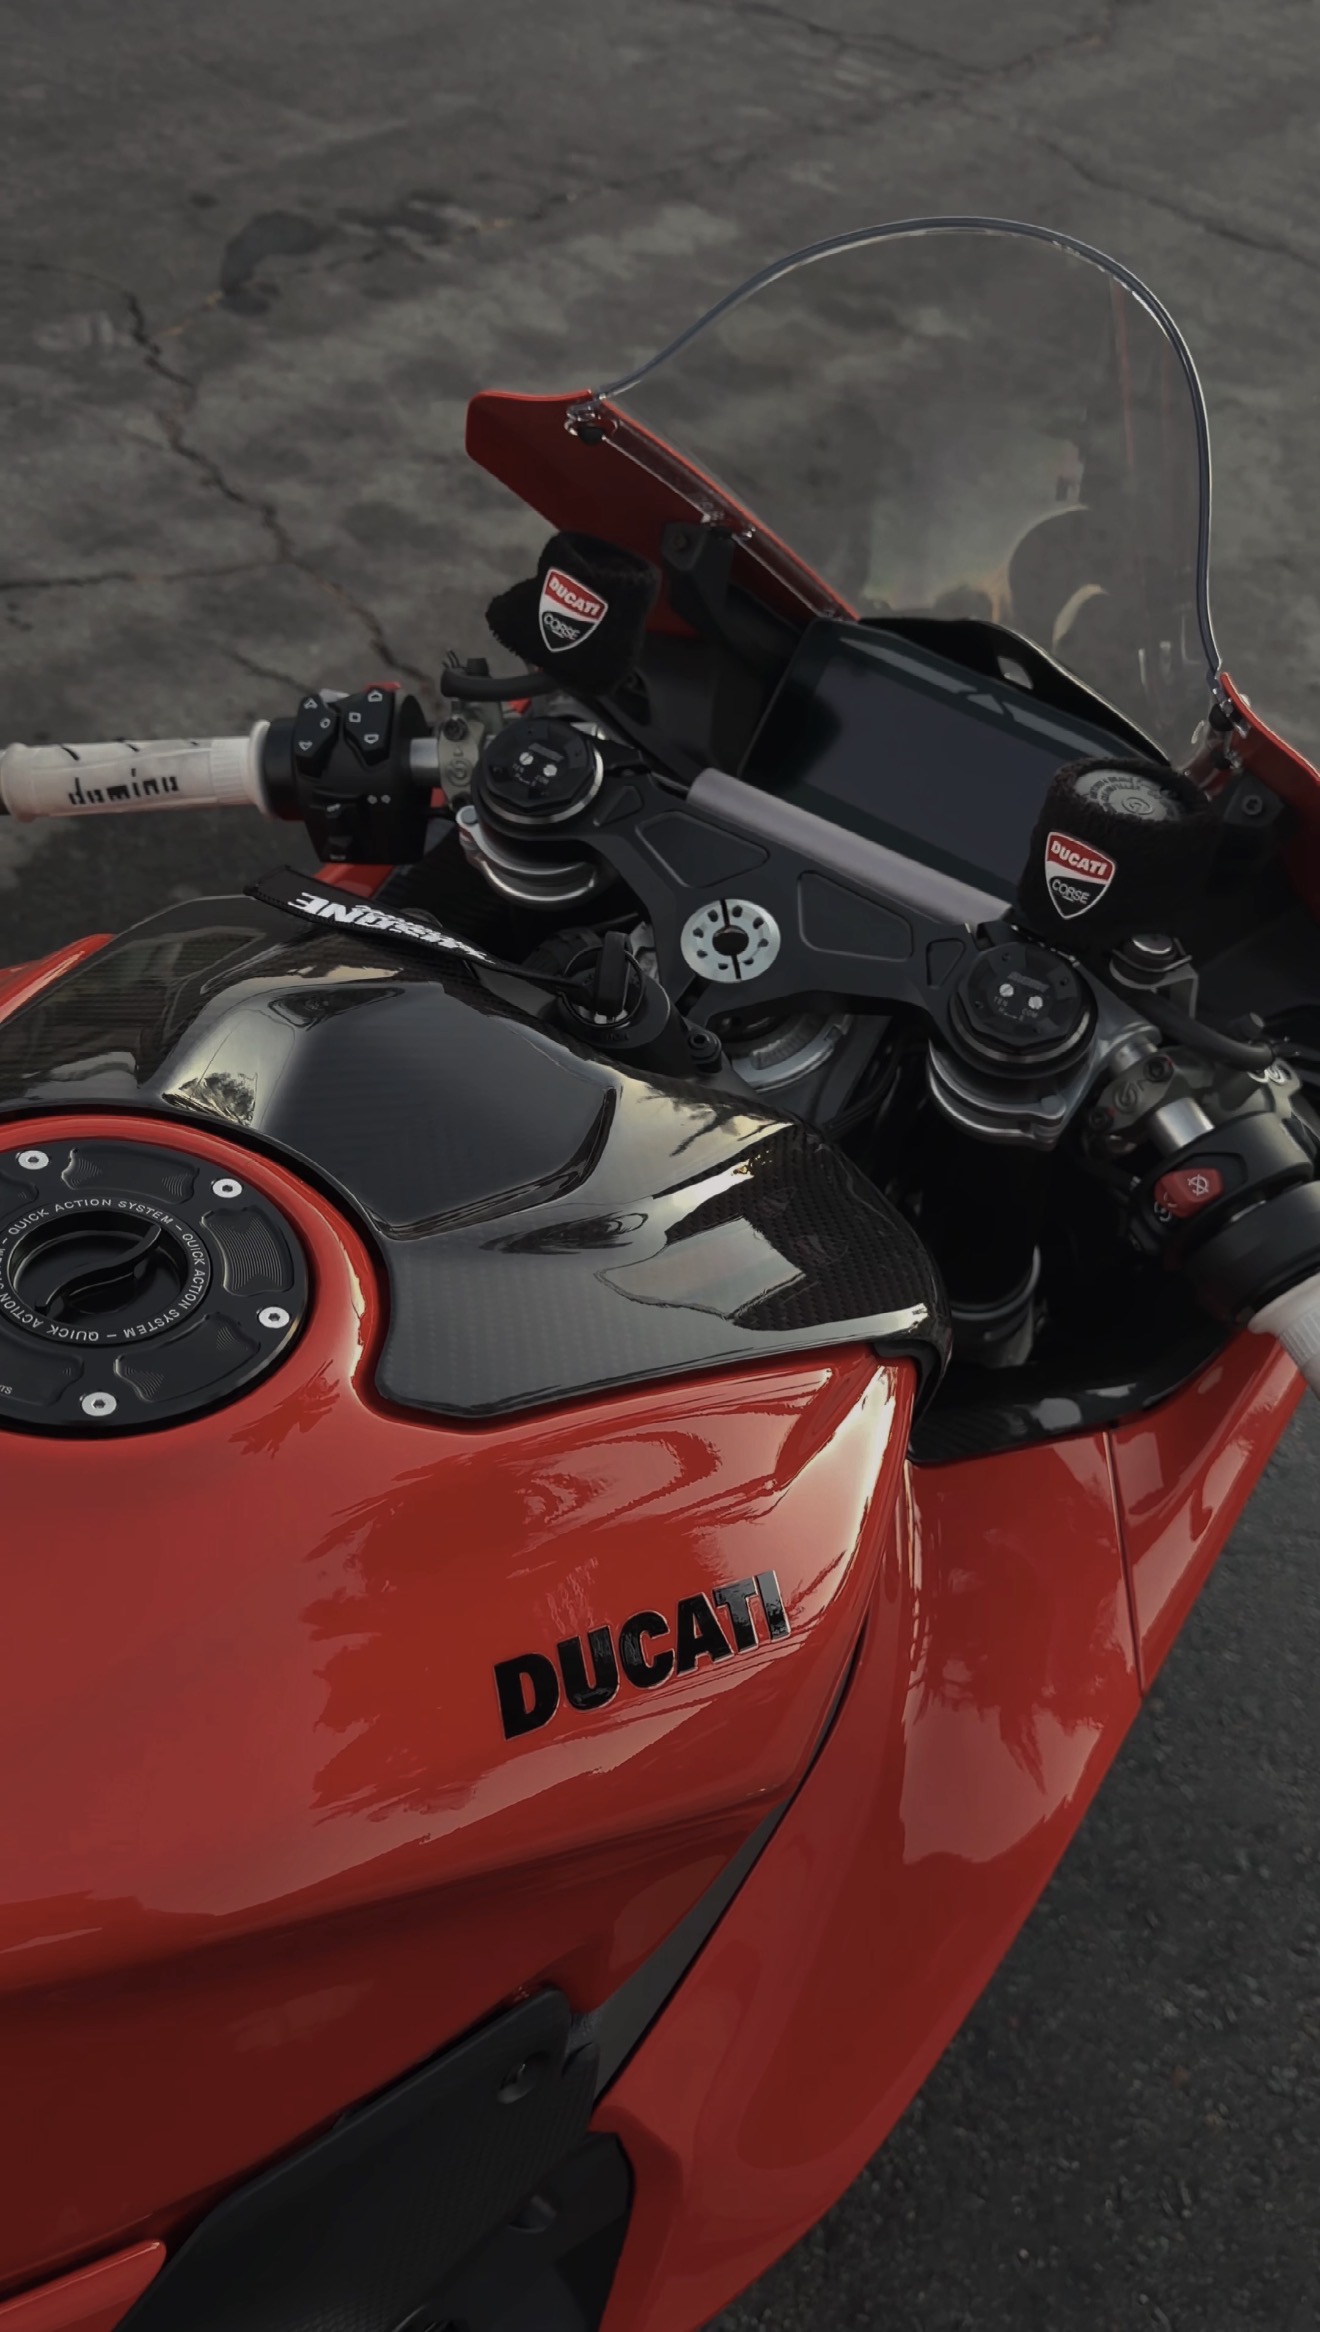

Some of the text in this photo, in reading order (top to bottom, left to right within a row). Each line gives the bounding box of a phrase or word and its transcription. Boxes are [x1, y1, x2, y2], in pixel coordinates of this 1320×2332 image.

[549, 576, 601, 616] DUCATI
[544, 613, 581, 640] CORSE
[1051, 840, 1108, 876] DUCATI
[1052, 879, 1091, 905] CORSE
[8, 1198, 174, 1235] QUICK ACTION SYSTEM
[123, 1233, 206, 1339] QUICK ACTION SYSTEM
[0, 1292, 99, 1341] QUICK ACTION
[494, 1569, 791, 1741] DUCATI
